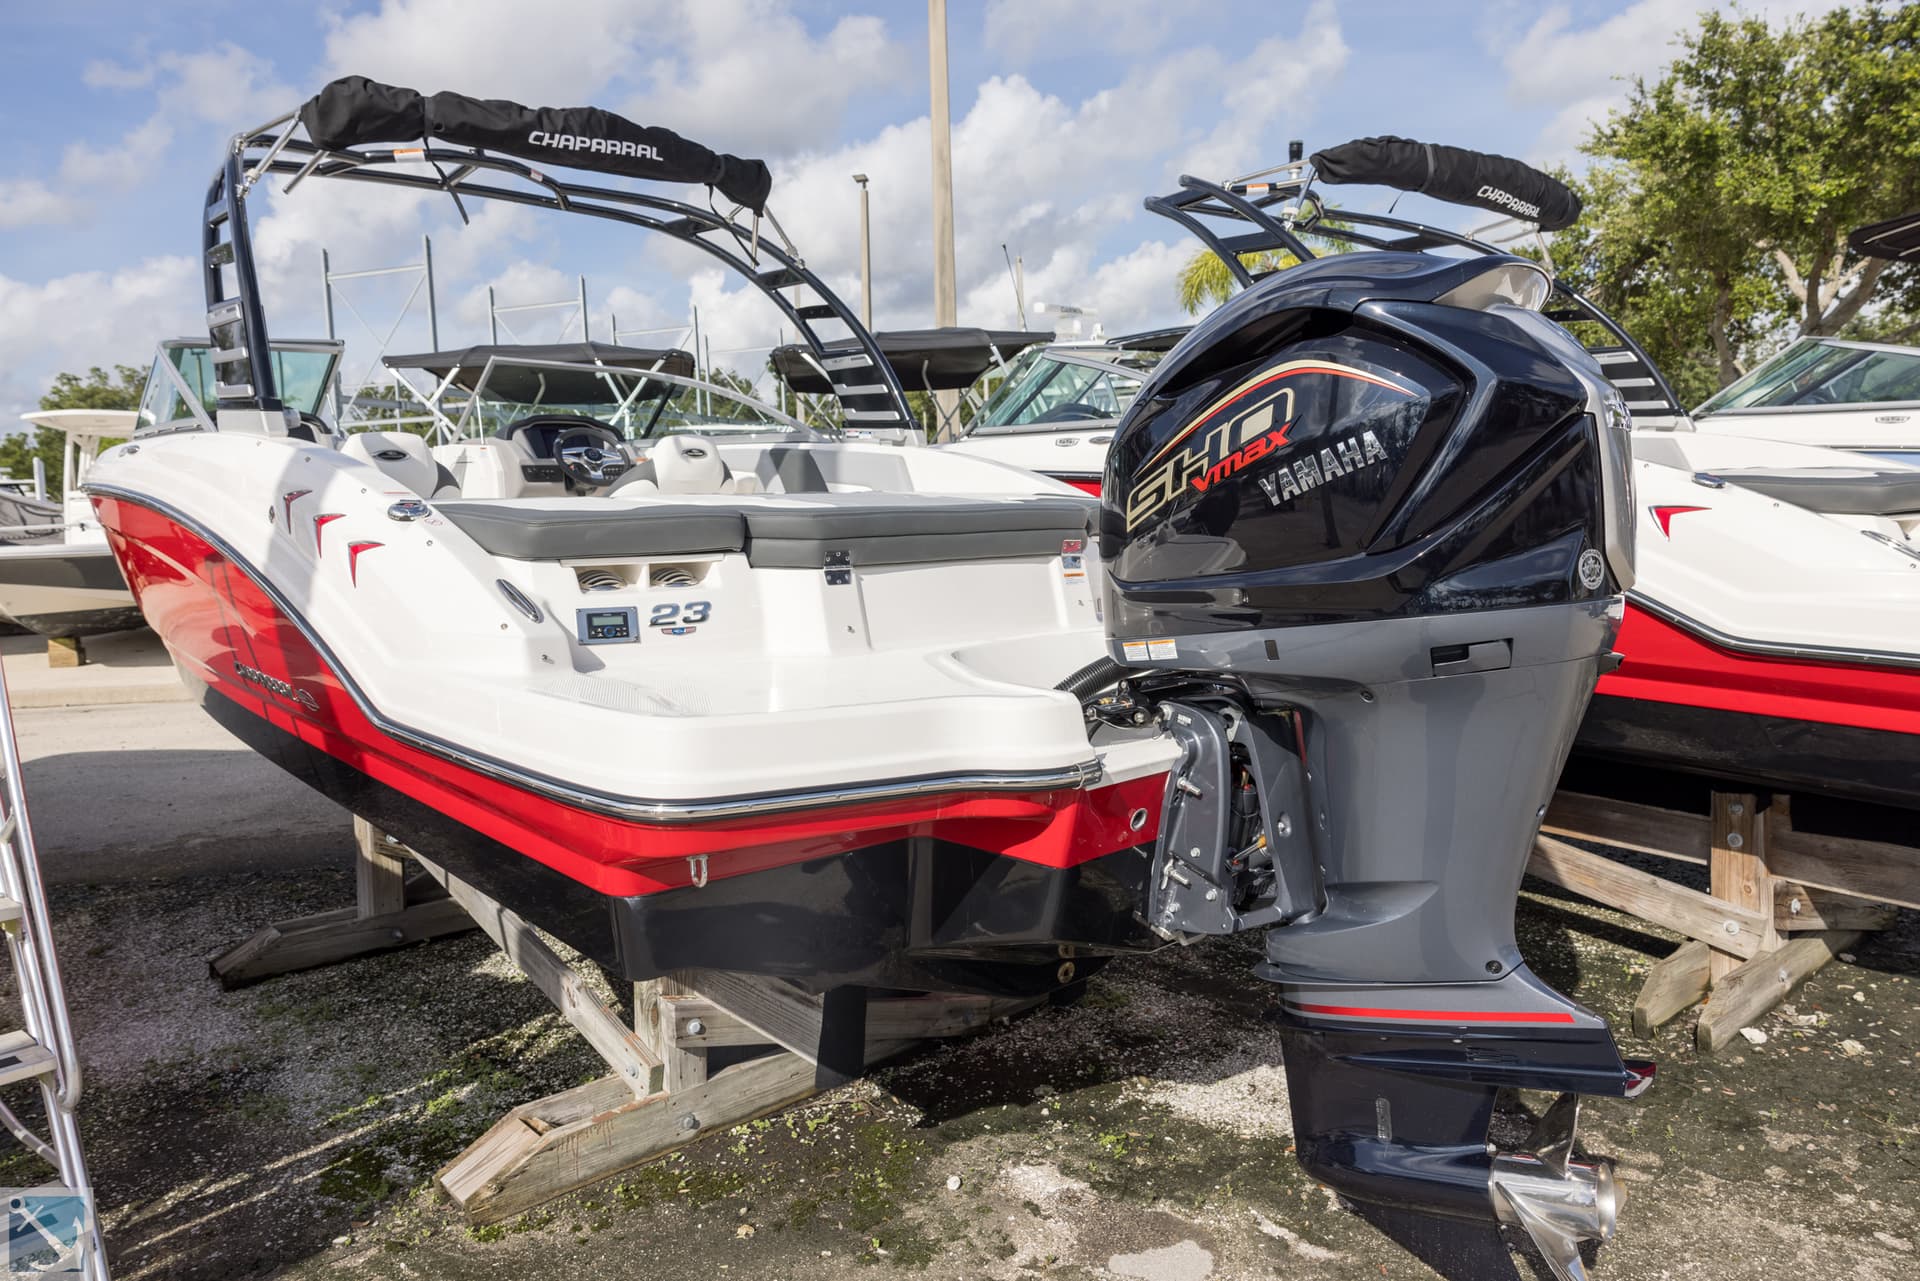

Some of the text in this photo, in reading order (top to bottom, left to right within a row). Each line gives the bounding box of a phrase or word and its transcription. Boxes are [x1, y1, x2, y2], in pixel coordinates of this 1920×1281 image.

[528, 130, 664, 162] CHAPARRAL
[1476, 184, 1540, 218] CHAPARRAL
[1258, 430, 1389, 507] YAMAHA
[649, 601, 712, 627] 23
